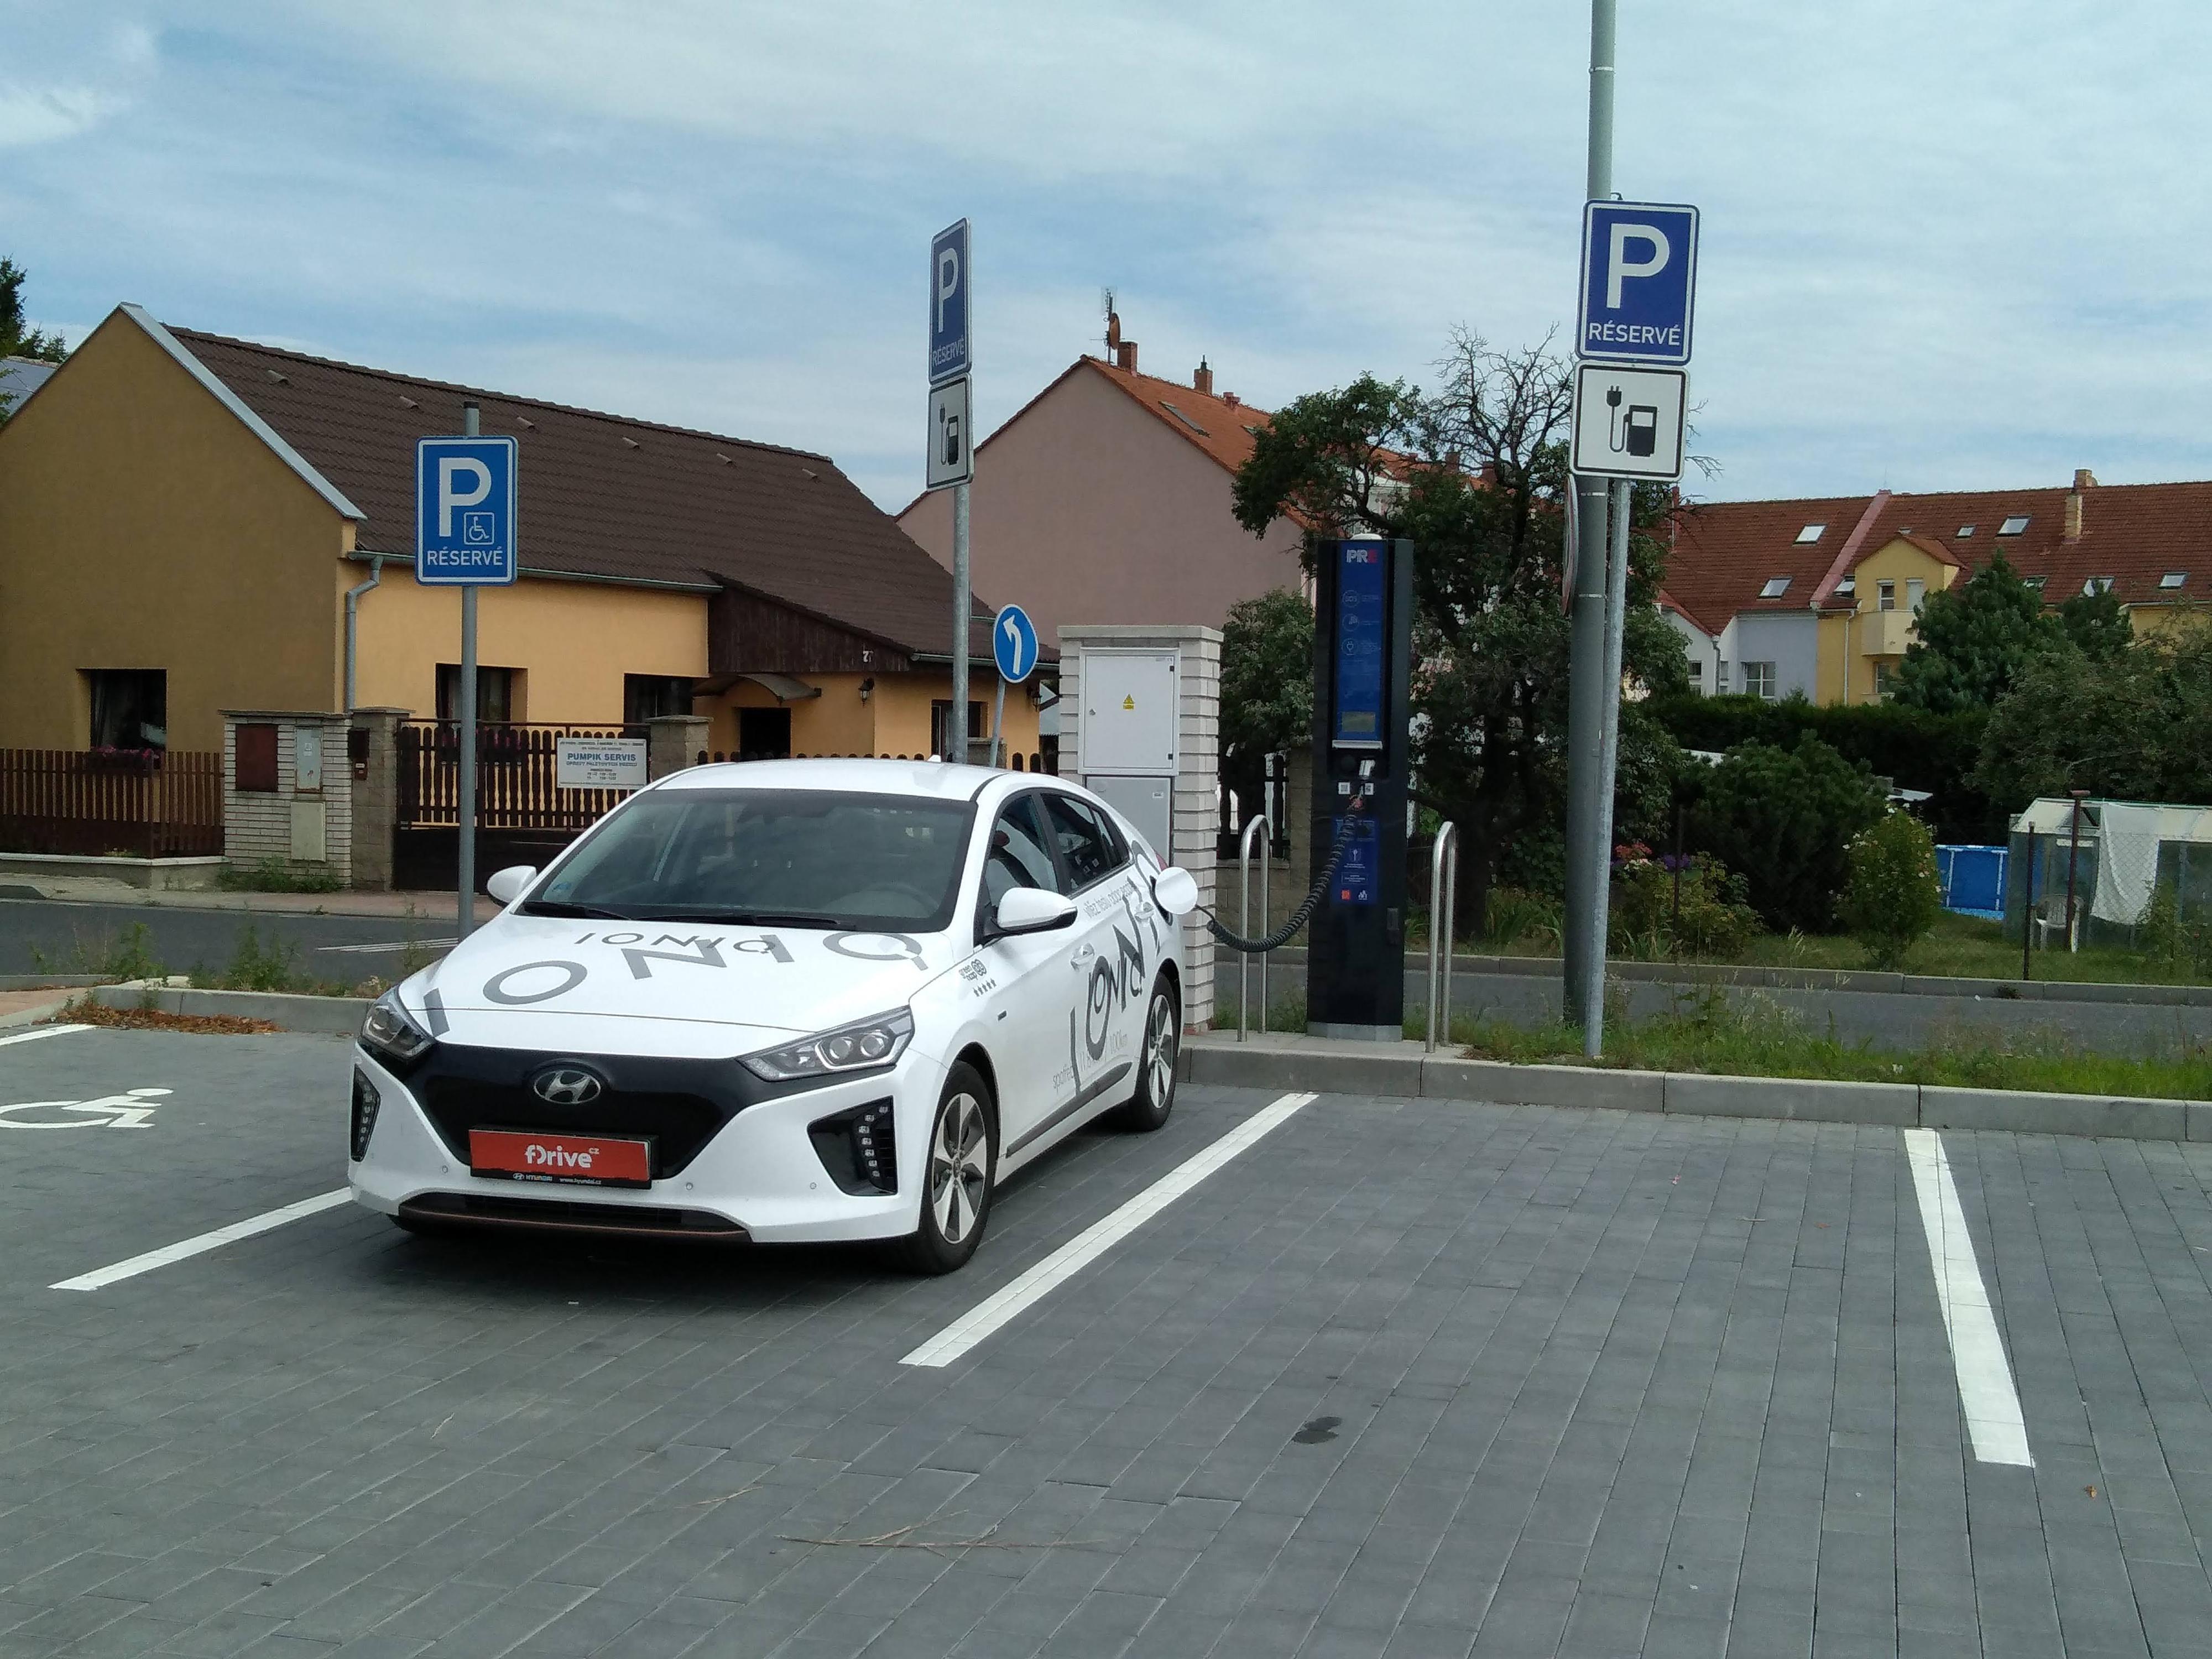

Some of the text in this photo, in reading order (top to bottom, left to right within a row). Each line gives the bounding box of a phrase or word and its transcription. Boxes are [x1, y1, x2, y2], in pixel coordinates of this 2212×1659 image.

[938, 248, 958, 333] P
[1606, 223, 1670, 309] P
[1588, 320, 1681, 346] RÉSERVÉ
[439, 457, 492, 537] P
[426, 546, 503, 566] RÉSERVÉ
[604, 753, 637, 761] SERVIS
[574, 932, 775, 954] IONIQ
[424, 931, 928, 1037] IONIQ
